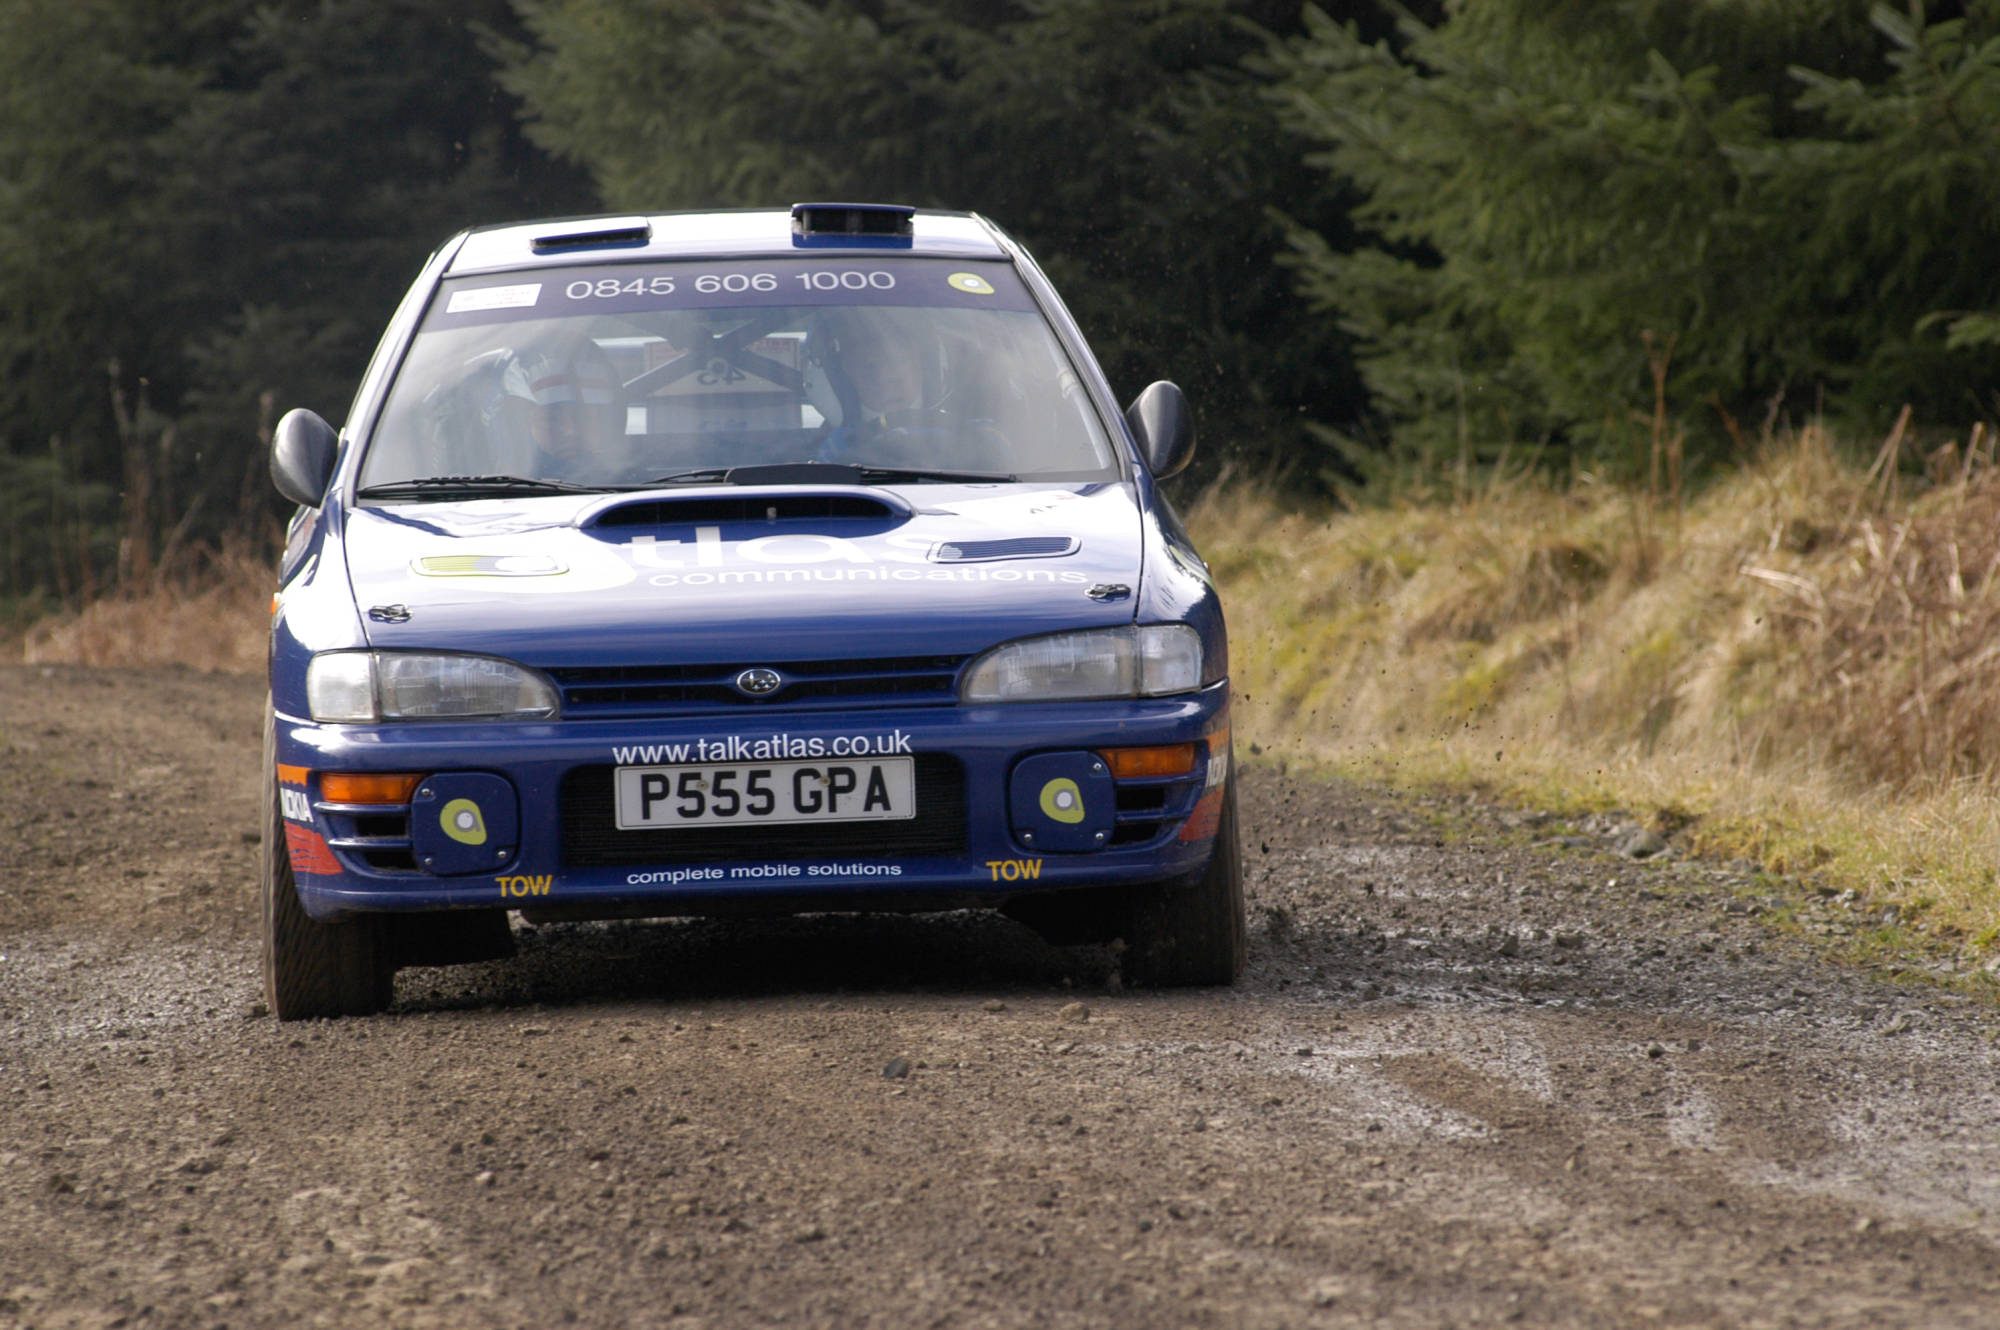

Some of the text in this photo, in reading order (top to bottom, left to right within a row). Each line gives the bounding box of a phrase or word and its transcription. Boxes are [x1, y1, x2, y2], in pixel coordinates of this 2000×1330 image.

[565, 271, 896, 300] 0845 606 1000
[648, 564, 1089, 586] communications
[612, 730, 913, 765] www.talkatlas.co.uk
[640, 765, 891, 820] P555 GPA
[627, 862, 902, 885] complete mobile solutions
[986, 859, 1043, 881] TOW
[495, 874, 553, 898] TOW
